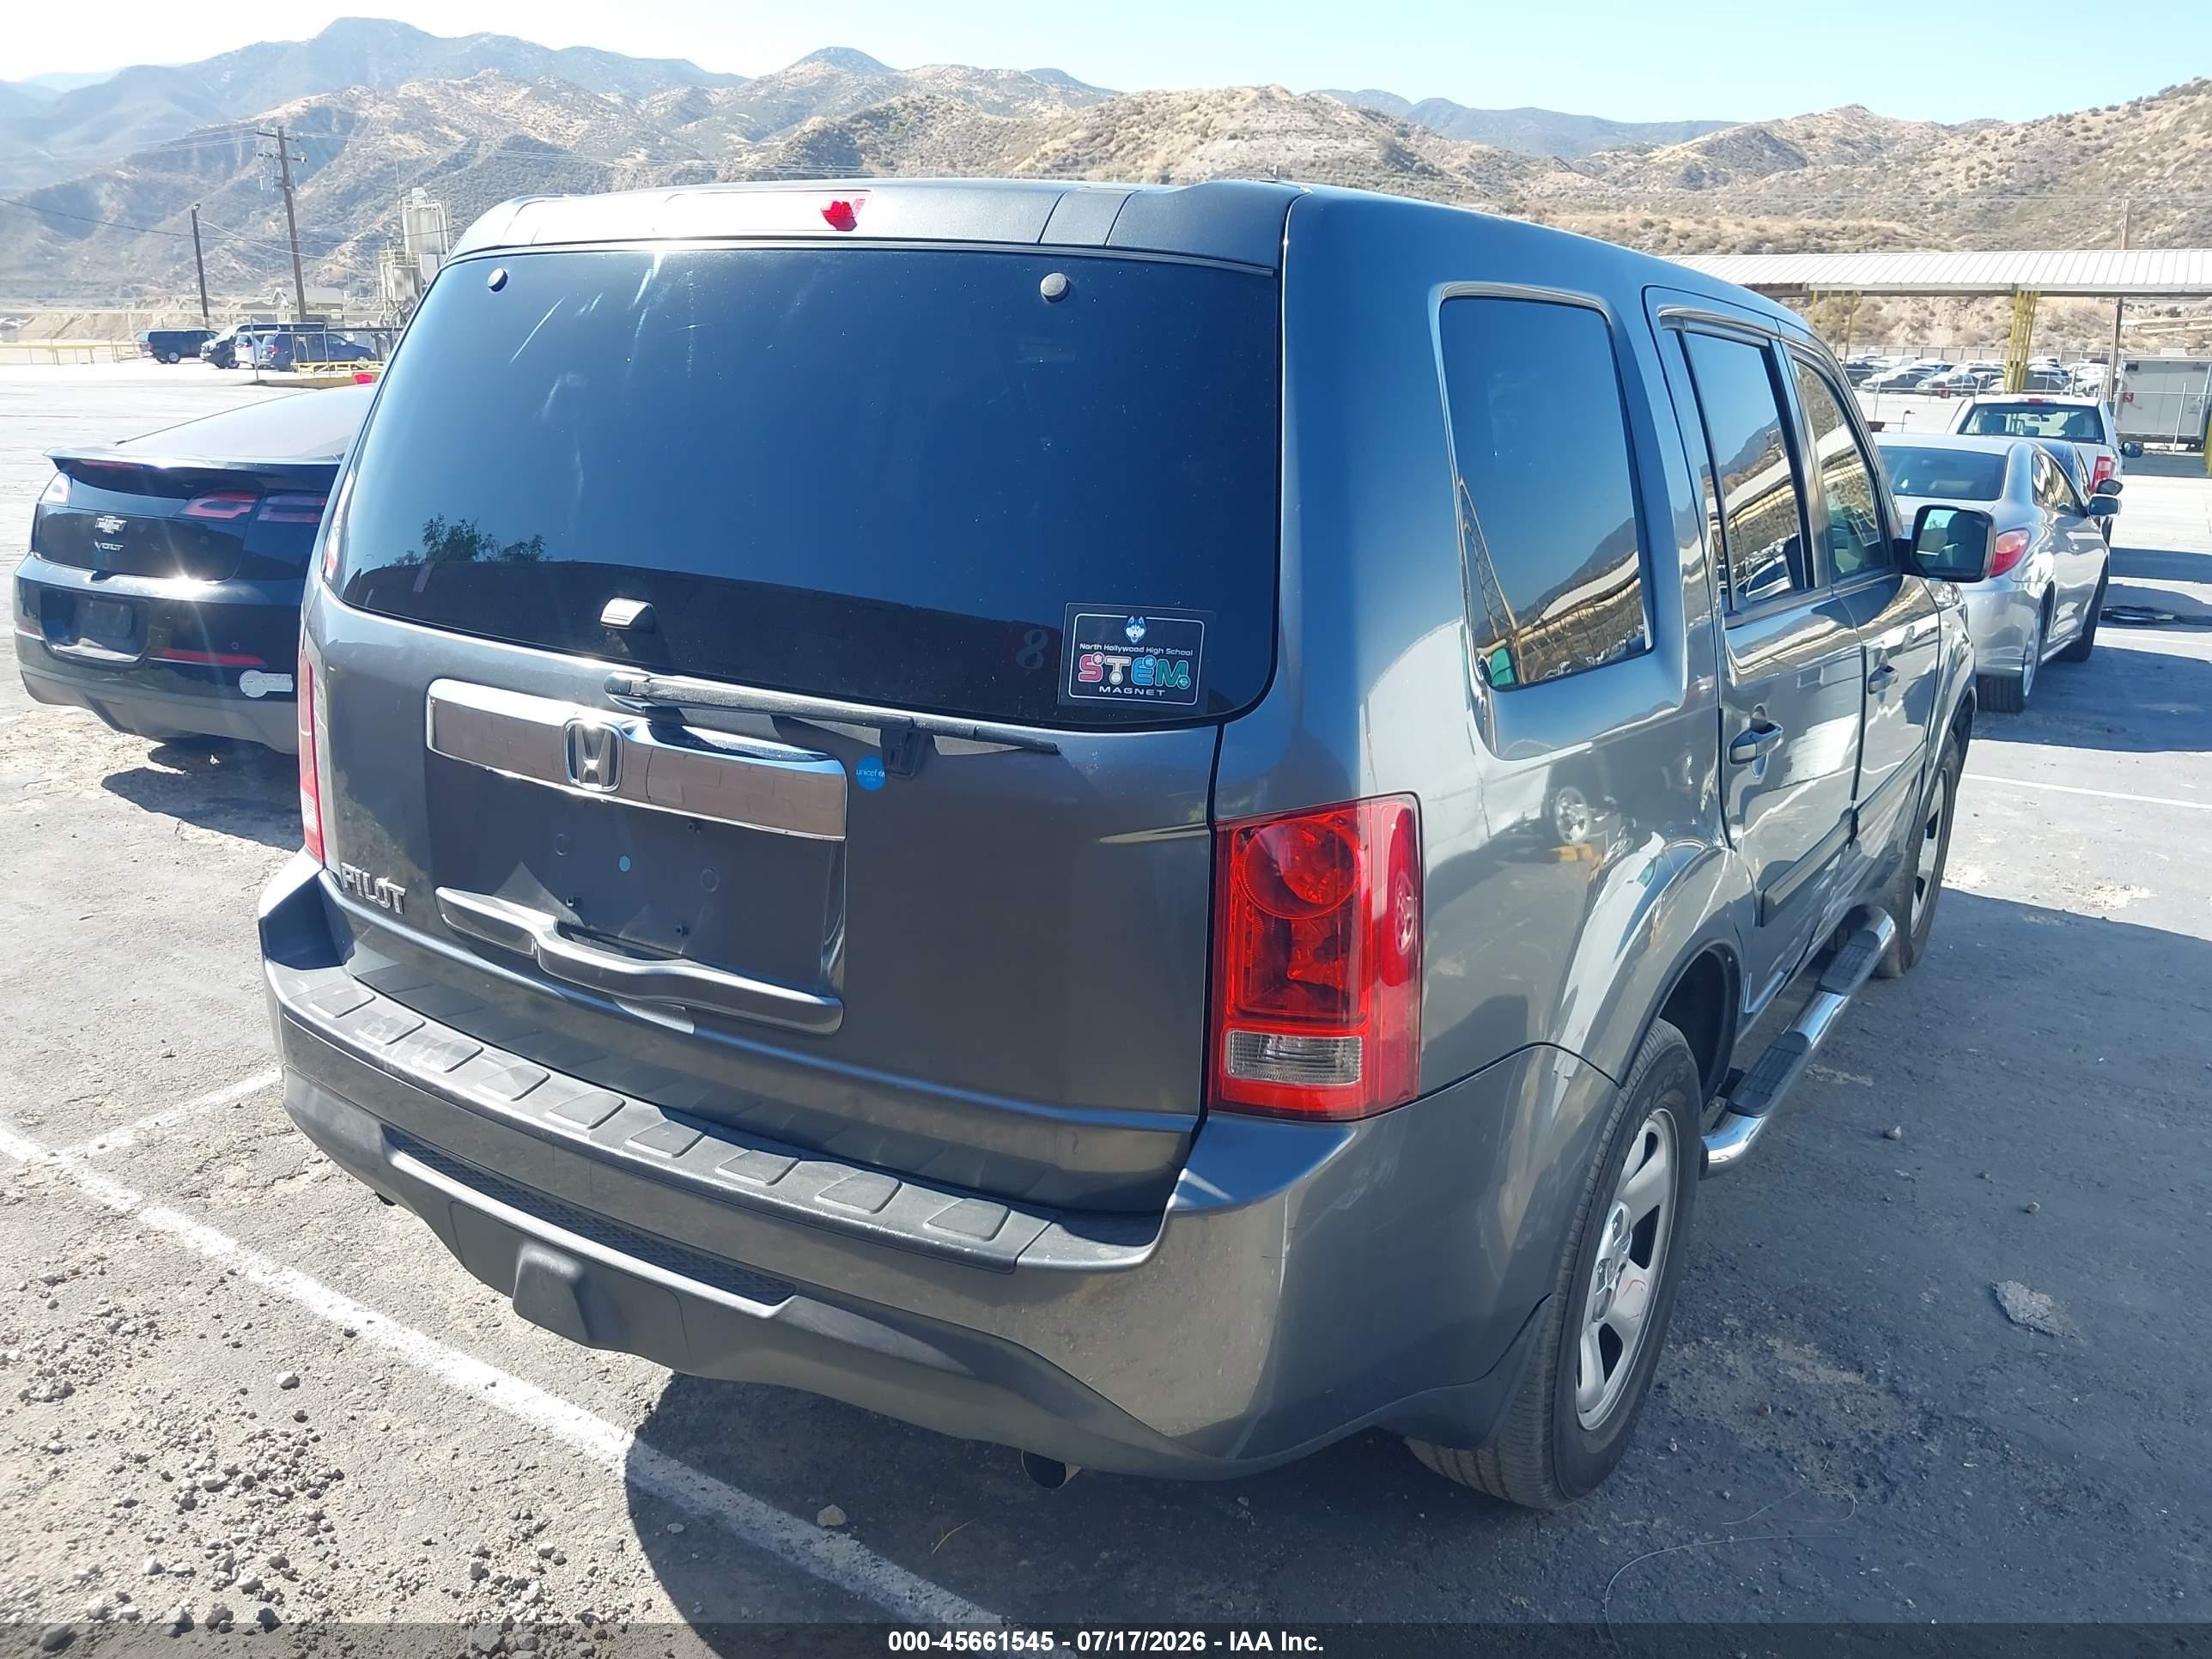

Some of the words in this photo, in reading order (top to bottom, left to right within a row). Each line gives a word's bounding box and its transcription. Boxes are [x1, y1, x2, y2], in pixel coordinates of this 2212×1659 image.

[94, 539, 125, 552] VOLT
[1103, 644, 1144, 653] Hollywood
[1146, 647, 1164, 655] High
[1078, 652, 1191, 690] STEM
[1098, 686, 1165, 696] MAGNET
[341, 861, 406, 915] PILOT
